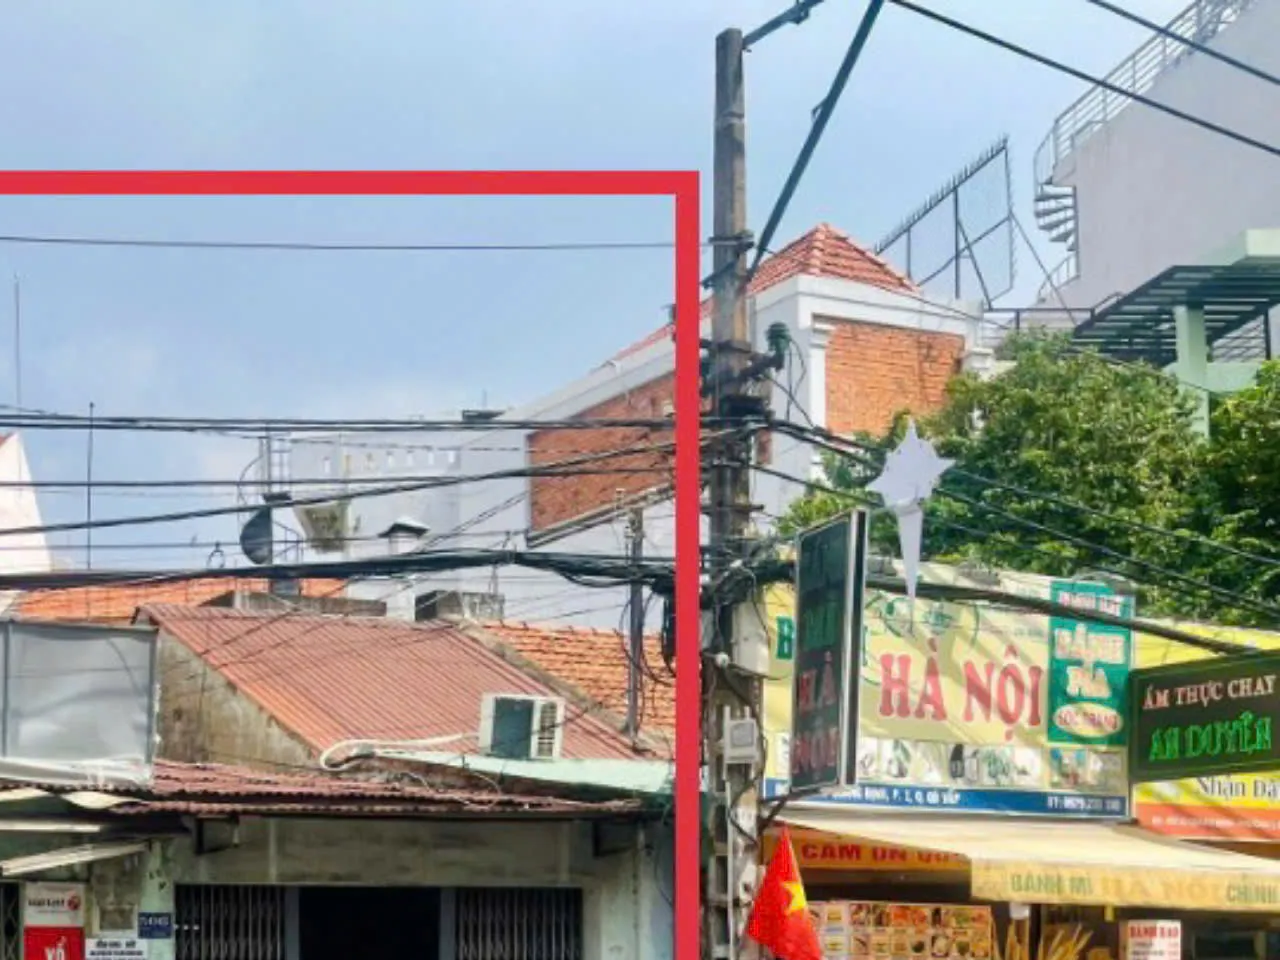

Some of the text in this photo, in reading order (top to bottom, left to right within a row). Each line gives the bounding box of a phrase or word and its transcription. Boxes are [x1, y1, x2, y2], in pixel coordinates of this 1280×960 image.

[878, 637, 1043, 742] HÀ NỘI
[1227, 674, 1277, 699] CHAY
